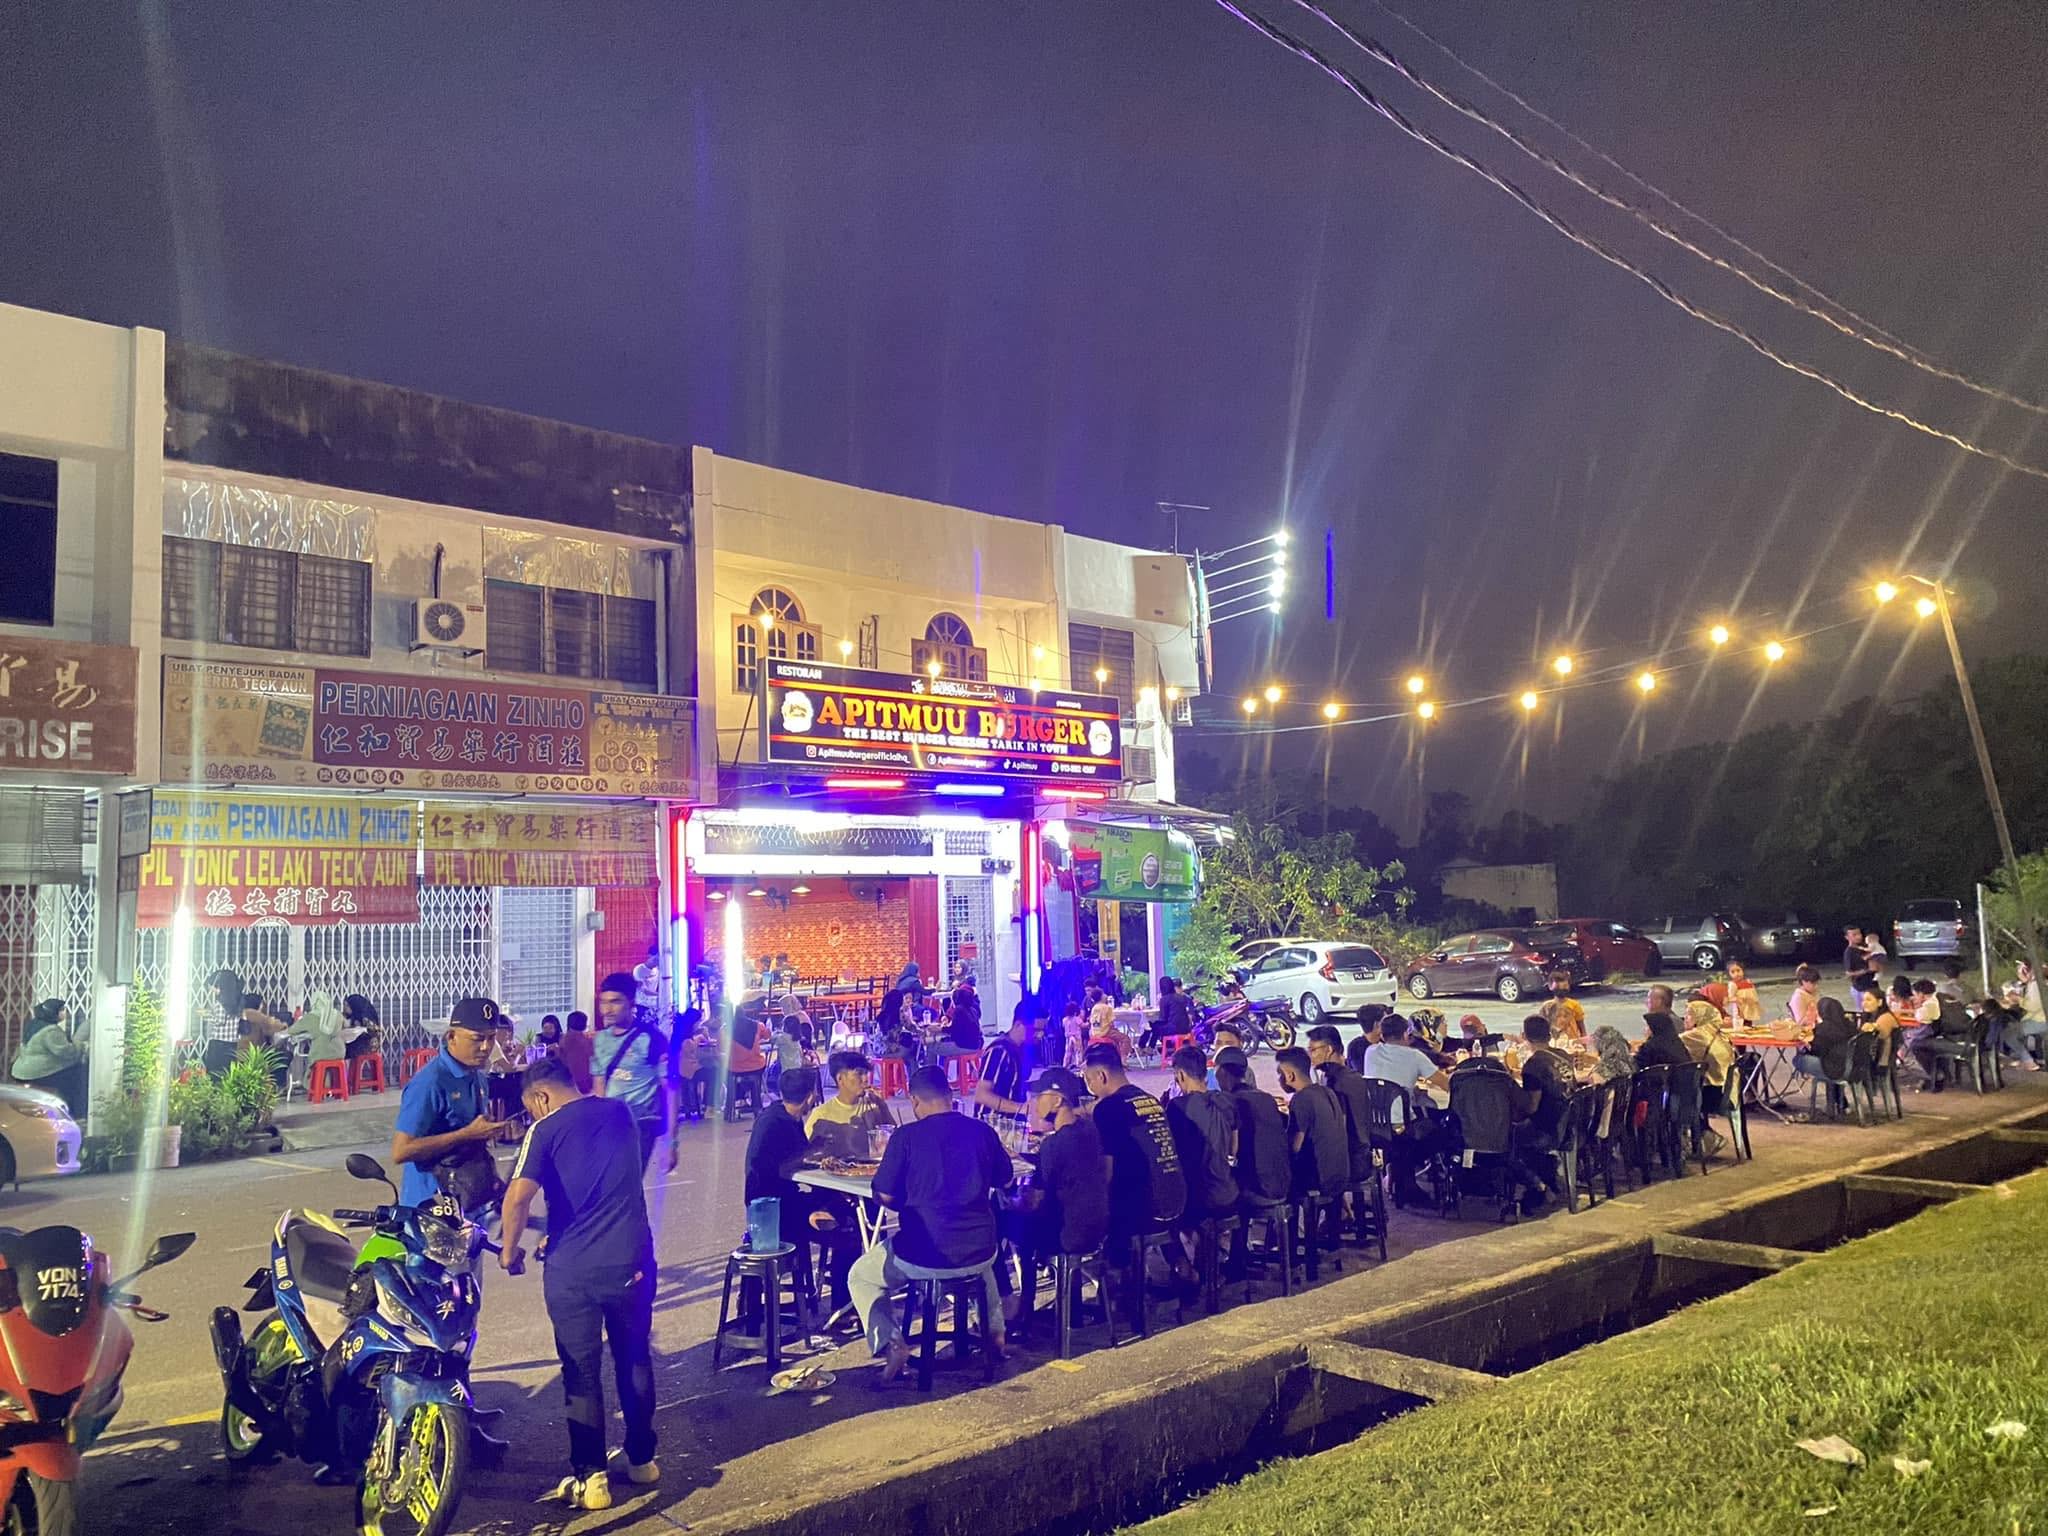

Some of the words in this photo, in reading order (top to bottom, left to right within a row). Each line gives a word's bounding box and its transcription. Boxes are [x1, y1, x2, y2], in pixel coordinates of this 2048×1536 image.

[0, 653, 96, 710] 易
[172, 663, 202, 673] UBAT
[206, 665, 265, 678] PENYEJUK
[269, 669, 305, 680] BADAN
[242, 678, 278, 692] TECK
[281, 680, 307, 693] AUN
[320, 681, 498, 724] PERNIAGAAN
[506, 694, 585, 729] ZINHO
[817, 695, 966, 735] APITMUU
[978, 710, 1088, 745] BURGER
[843, 727, 869, 740] THE
[870, 729, 900, 742] BEST
[902, 732, 947, 746] BURGER
[990, 739, 1025, 751] TARIK
[1026, 742, 1038, 752] IN
[1039, 744, 1068, 755] TOWN
[189, 801, 220, 817] UBAT
[228, 804, 349, 841] PERNIAGAAN
[359, 807, 410, 842] ZINHO
[181, 824, 220, 840] ARAK
[141, 848, 173, 886] PIL
[180, 849, 240, 886] TONIC
[245, 849, 313, 886] LELAKI
[320, 851, 367, 887] TECK
[372, 852, 408, 887] AUN
[434, 852, 461, 886] PIL
[466, 852, 509, 886] TONIC
[513, 853, 577, 886] WANITA
[582, 854, 616, 886] TECK
[37, 1282, 79, 1300] 7174
